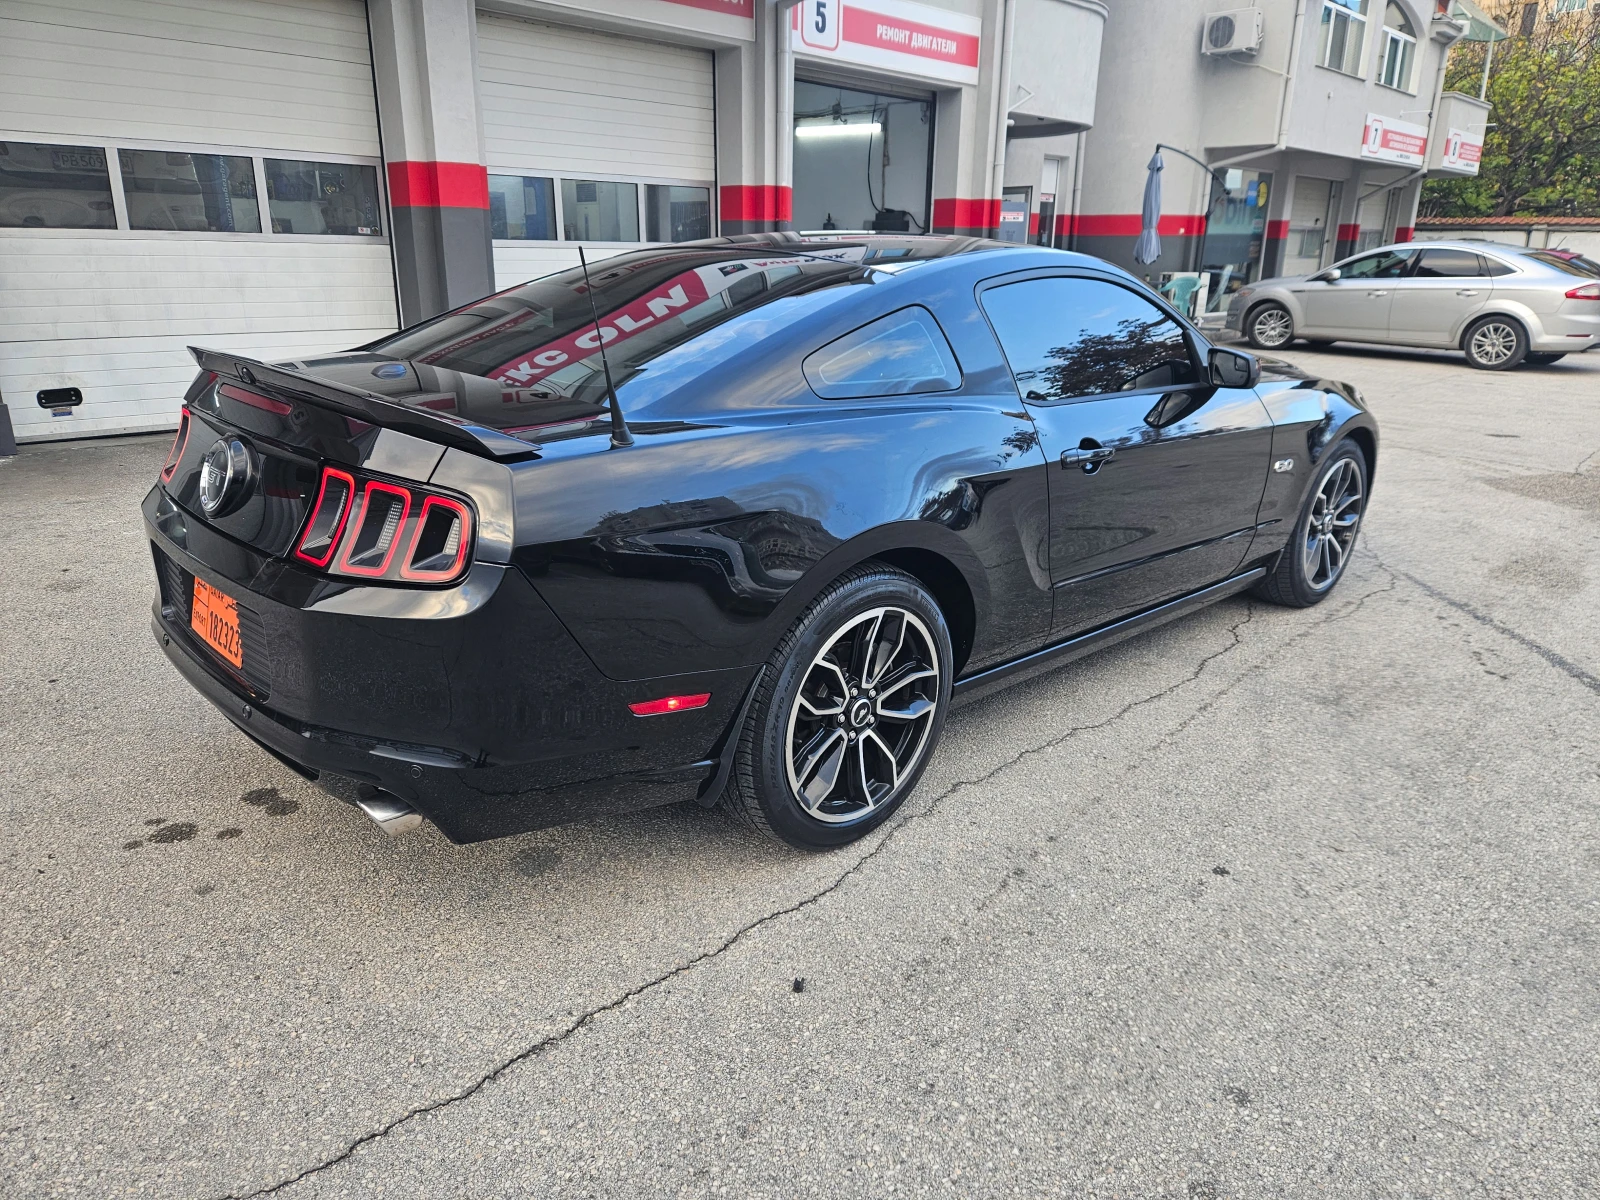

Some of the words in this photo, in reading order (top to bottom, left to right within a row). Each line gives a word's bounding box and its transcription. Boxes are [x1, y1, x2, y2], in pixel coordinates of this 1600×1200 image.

[815, 1, 827, 33] 5
[876, 23, 910, 45] РЕМОНТ
[911, 31, 957, 55] ДВИГАТЕЛИ
[209, 610, 240, 659] 182323
